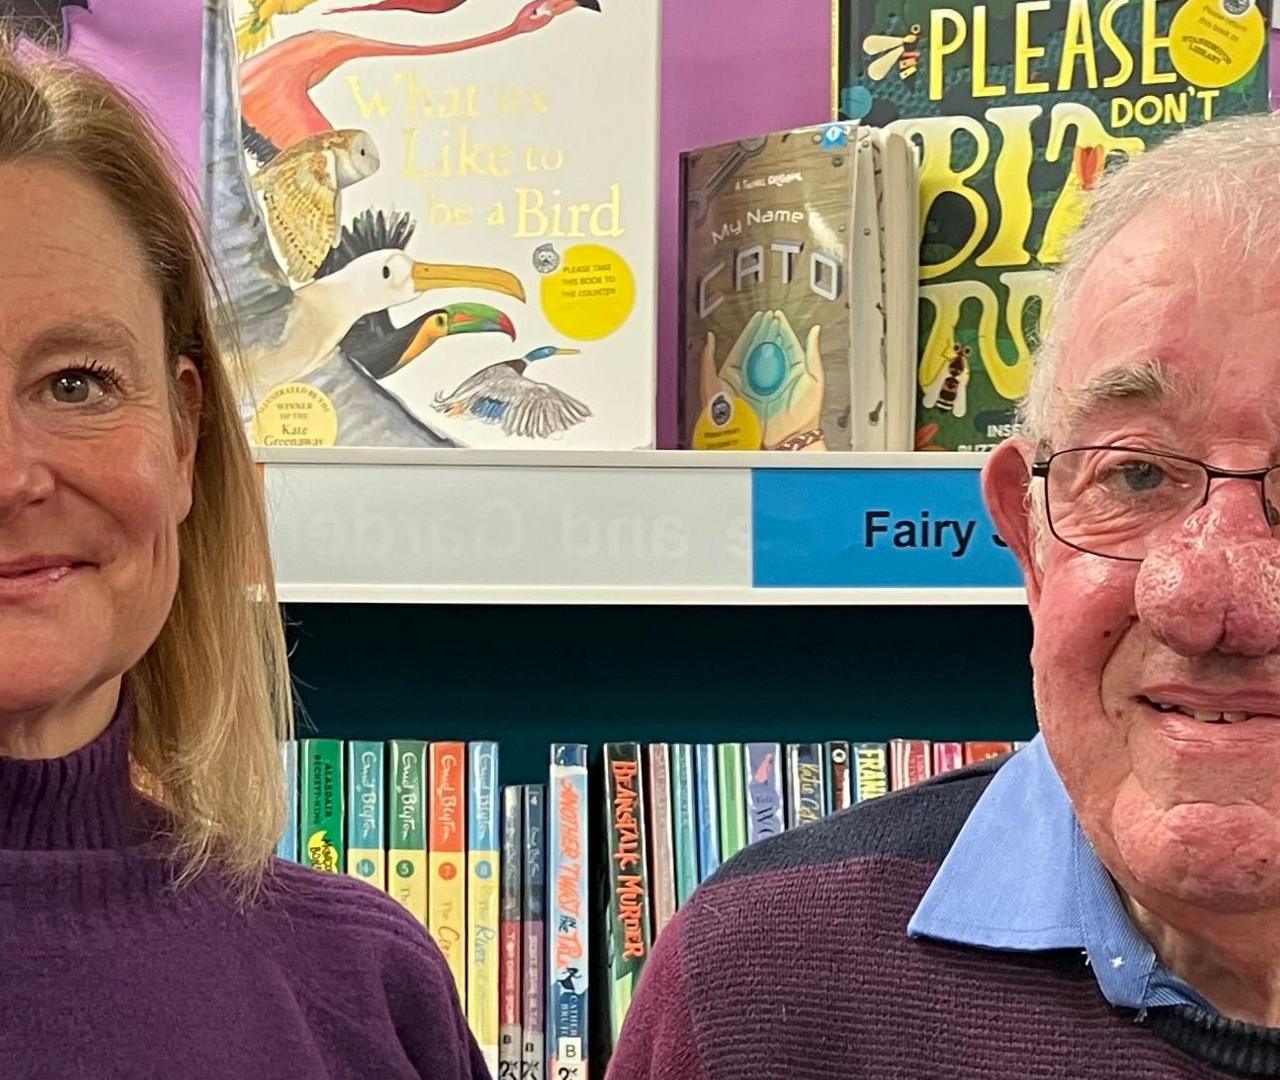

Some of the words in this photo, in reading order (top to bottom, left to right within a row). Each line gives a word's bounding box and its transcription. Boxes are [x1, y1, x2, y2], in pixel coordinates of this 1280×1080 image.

[929, 0, 1174, 101] PLEASE
[345, 70, 481, 119] What
[1111, 86, 1219, 128] DON'T
[403, 125, 511, 180] Like
[525, 144, 564, 172] to
[429, 190, 472, 228] be
[487, 201, 505, 226] a
[513, 182, 624, 238] Bird
[711, 220, 742, 245] My
[747, 208, 804, 226] Name
[698, 240, 842, 318] CATO
[281, 424, 308, 436] Kate
[865, 511, 977, 559] Fairy
[437, 754, 457, 791] Enid
[440, 796, 456, 842] Blyton
[610, 761, 639, 870] BEANSTALK
[617, 875, 646, 960] MURDER
